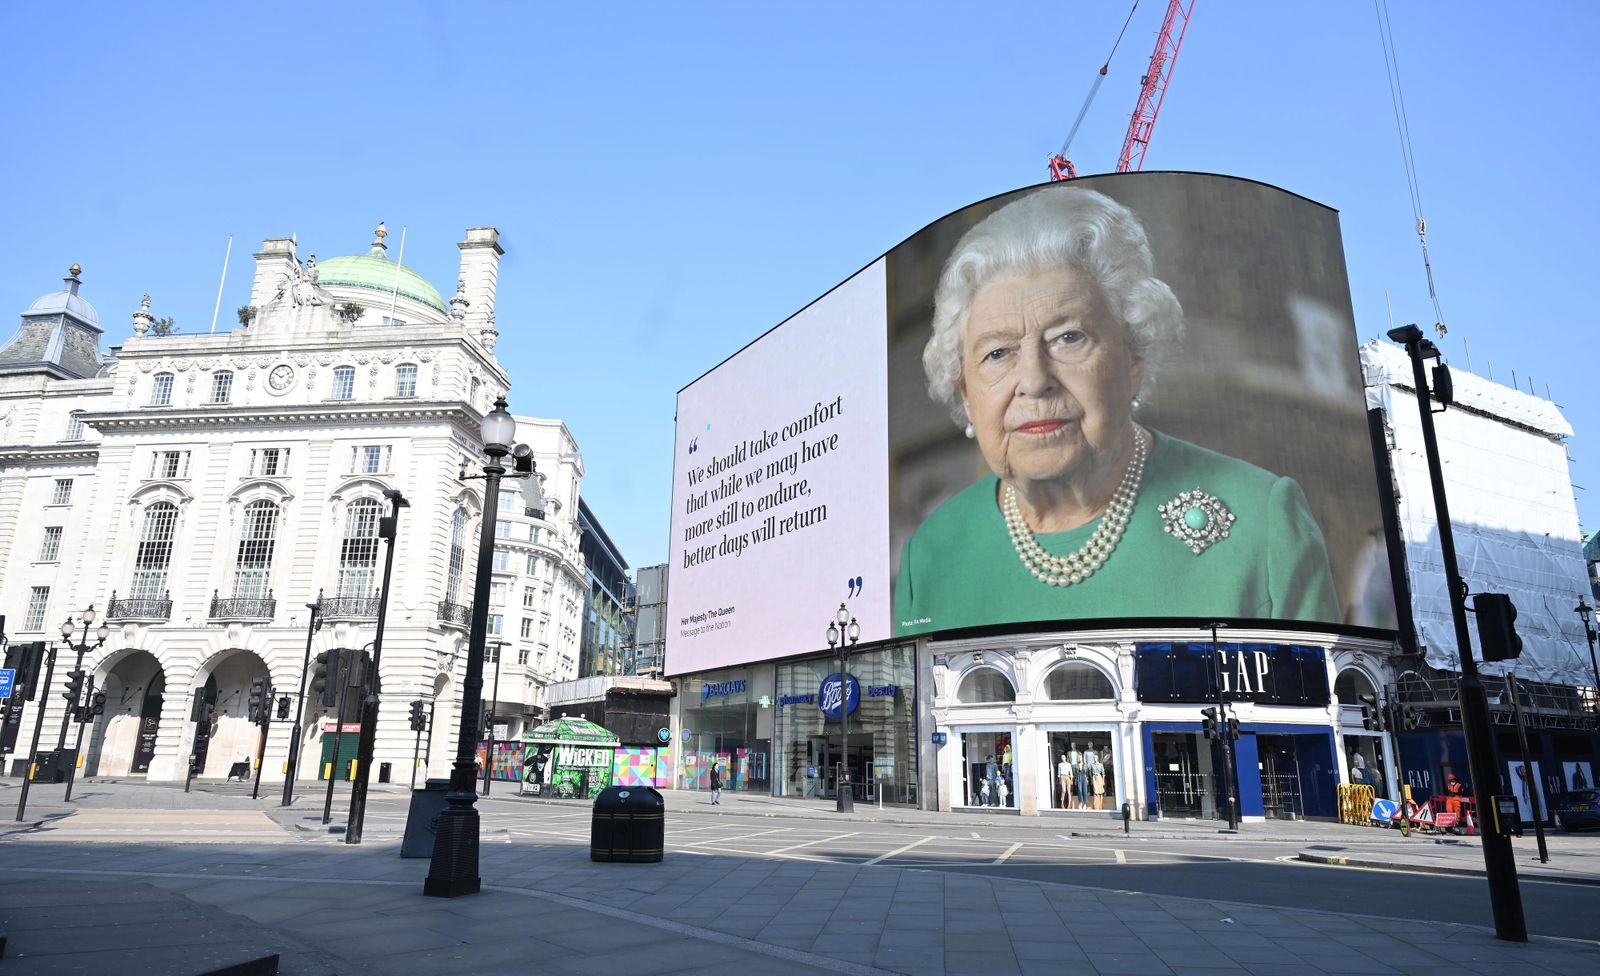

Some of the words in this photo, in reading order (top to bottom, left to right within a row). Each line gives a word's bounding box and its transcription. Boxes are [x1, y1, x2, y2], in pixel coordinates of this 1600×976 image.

[687, 467, 704, 487] We
[706, 441, 747, 479] should
[750, 430, 778, 458] take
[781, 395, 843, 442] comfort
[686, 490, 708, 514] that
[711, 474, 743, 503] while
[745, 468, 763, 487] we
[766, 452, 798, 475] may
[802, 433, 839, 464] have
[683, 543, 717, 569] better
[718, 533, 749, 558] days
[751, 516, 775, 545] will
[779, 505, 828, 536] return
[685, 518, 714, 542] more
[716, 501, 738, 530] still
[741, 500, 754, 519] to
[757, 479, 812, 512] endure,
[681, 617, 689, 626] Her
[690, 612, 707, 624] Majesty
[708, 610, 718, 619] The
[718, 606, 735, 617] Queen
[709, 680, 746, 697] BARCLAYS
[1409, 770, 1430, 788] GAP
